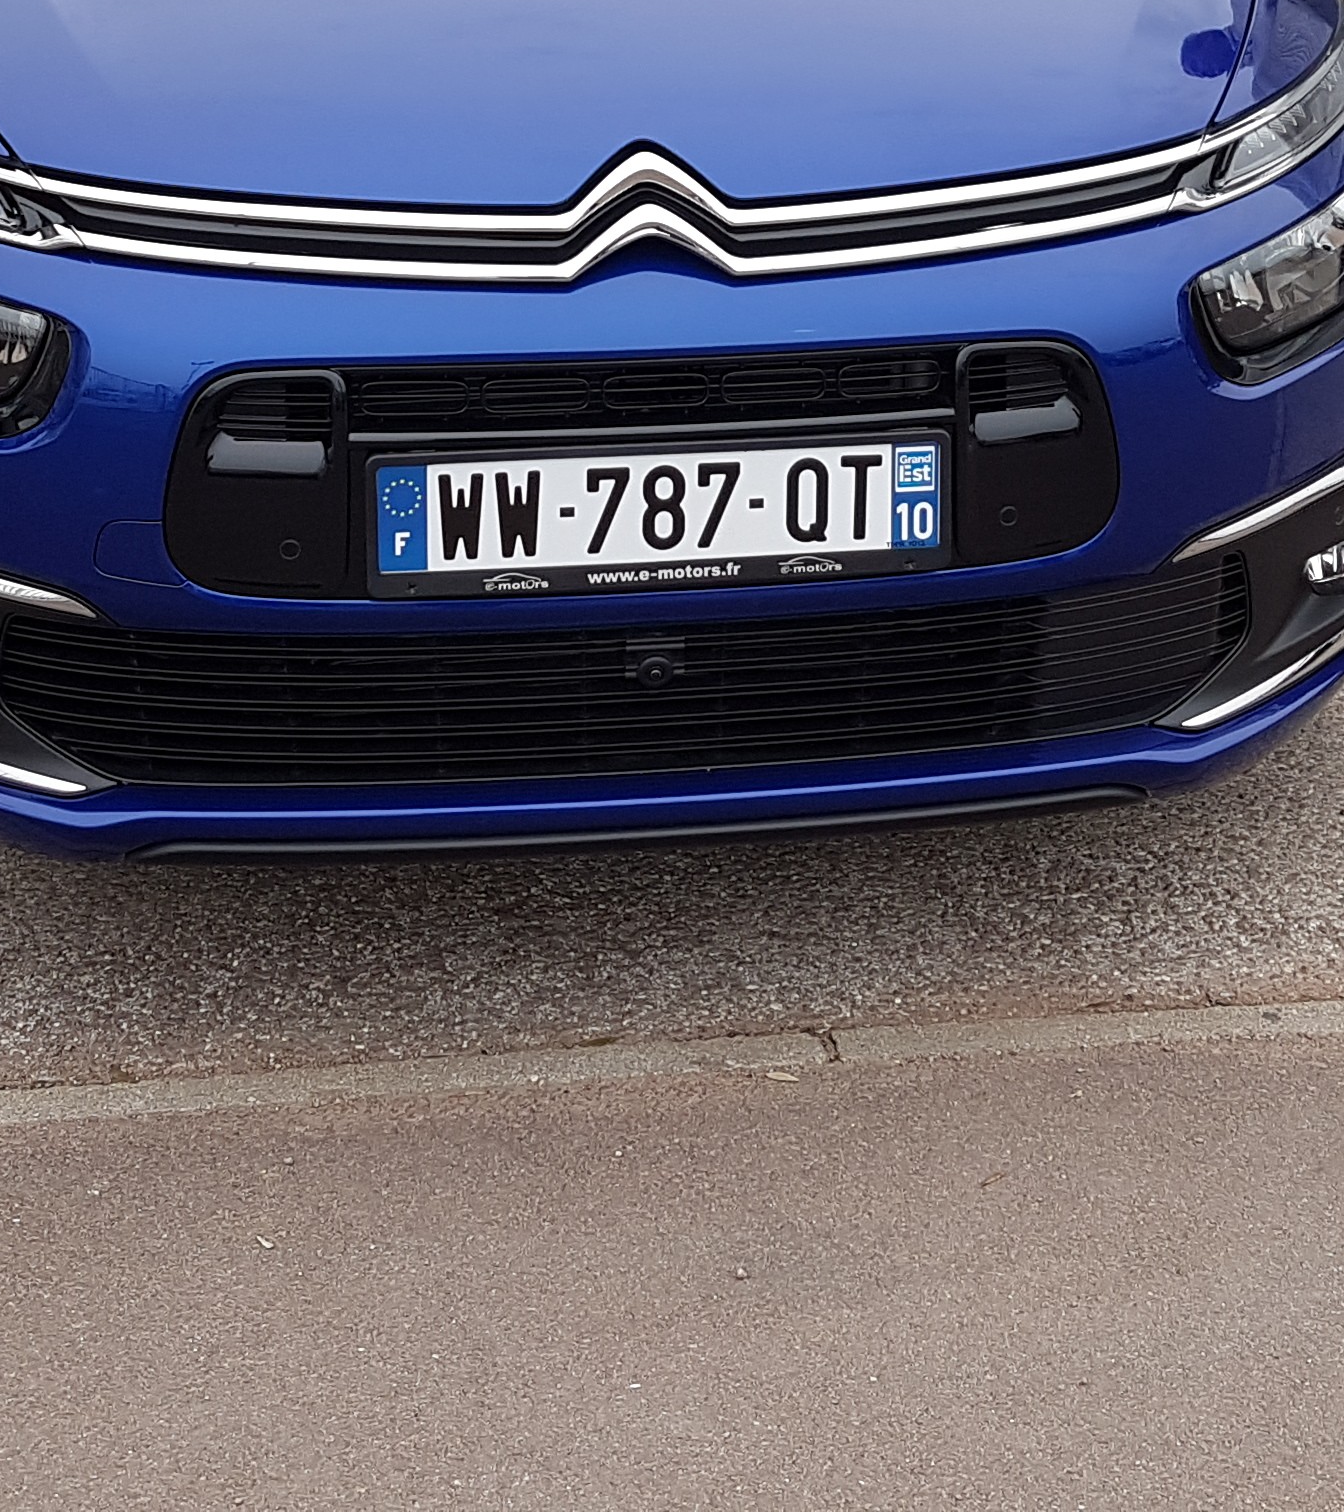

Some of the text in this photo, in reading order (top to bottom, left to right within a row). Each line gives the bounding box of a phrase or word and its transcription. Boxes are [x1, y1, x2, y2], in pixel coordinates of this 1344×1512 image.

[899, 453, 932, 464] Grand
[899, 464, 931, 482] Est
[896, 501, 934, 541] 10
[394, 532, 411, 556] F
[587, 562, 742, 584] www.e-motors.fr
